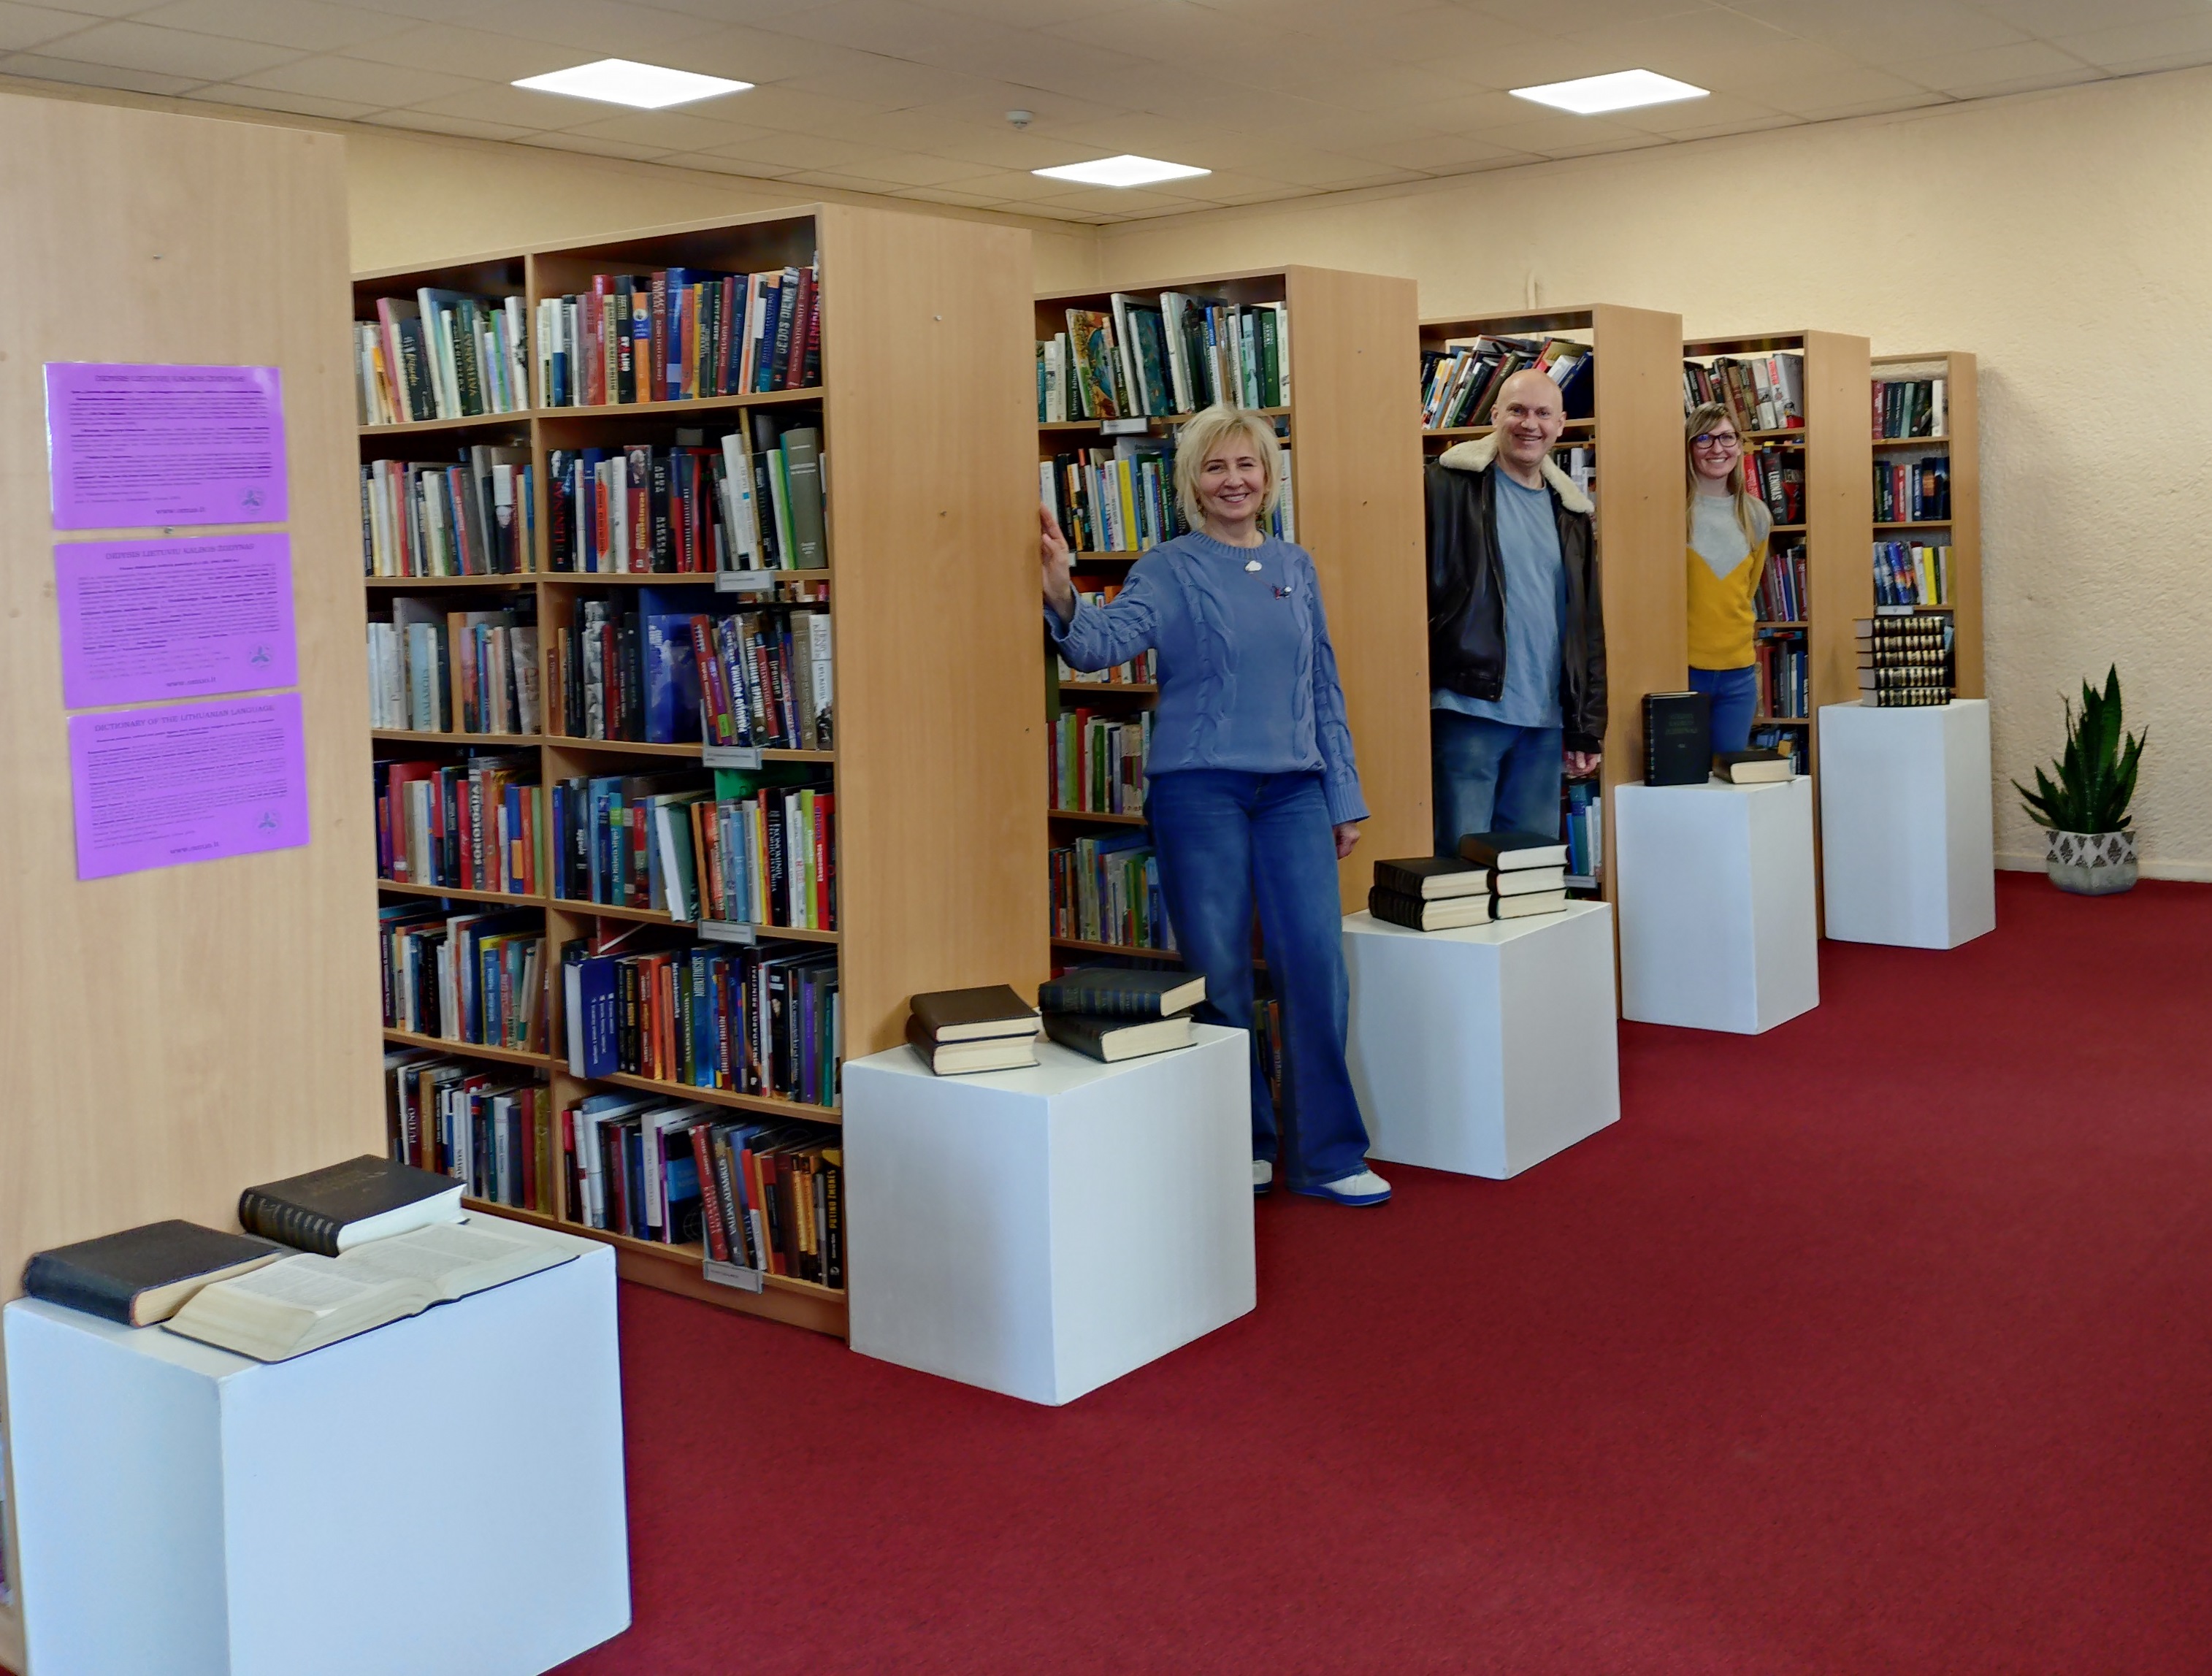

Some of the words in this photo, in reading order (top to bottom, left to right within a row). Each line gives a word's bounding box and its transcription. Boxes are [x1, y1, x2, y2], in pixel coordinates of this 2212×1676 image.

[1768, 471, 1783, 501] LENINAS
[553, 481, 566, 543] LENINAS
[95, 716, 146, 732] DICTIONARY
[148, 716, 159, 724] OF
[161, 713, 178, 724] THE
[180, 709, 229, 722] LITHUANIAN
[231, 705, 275, 716] LANGUAGE
[828, 1201, 838, 1228] PUTINO
